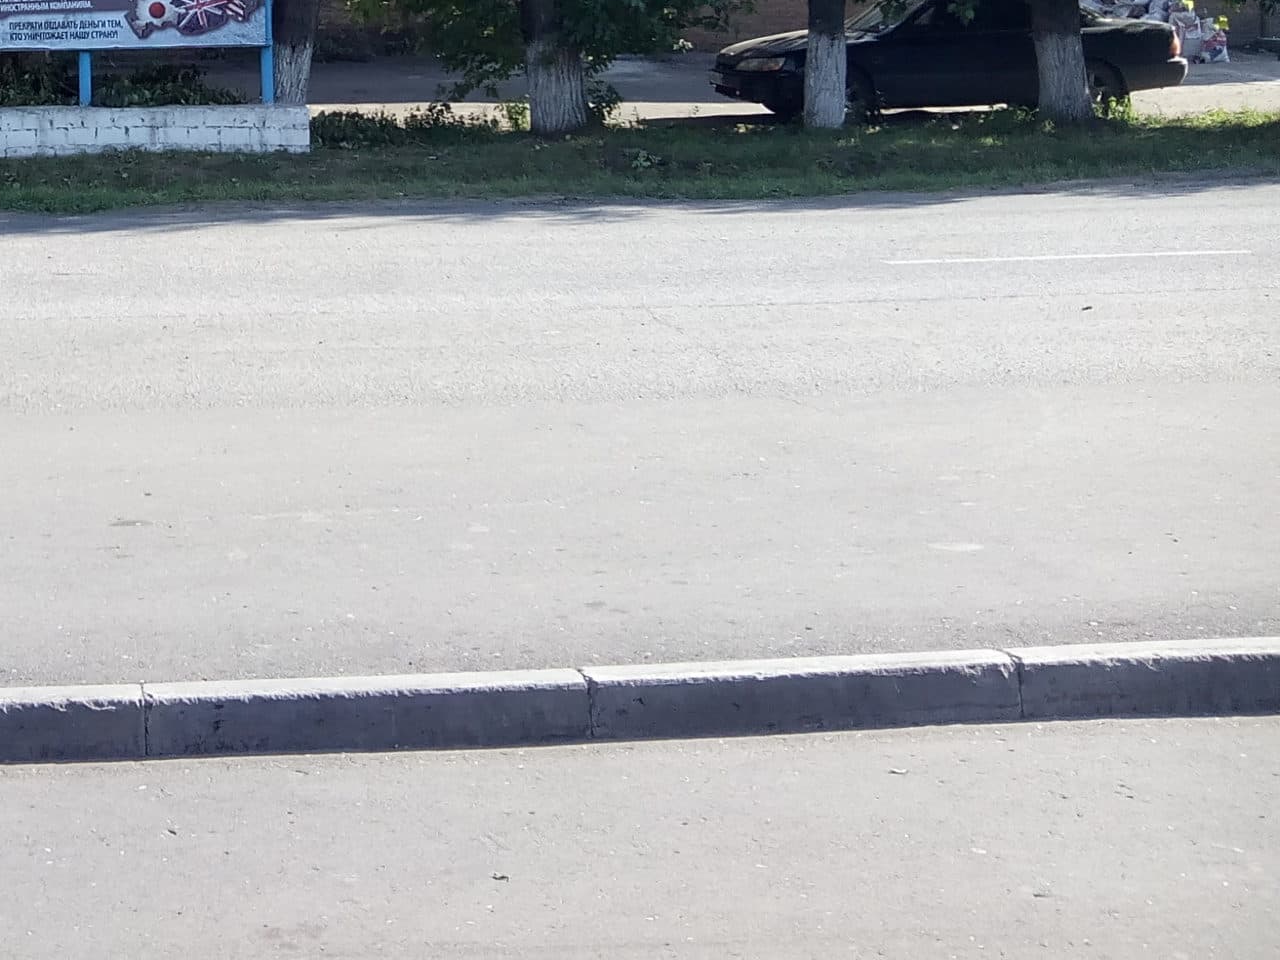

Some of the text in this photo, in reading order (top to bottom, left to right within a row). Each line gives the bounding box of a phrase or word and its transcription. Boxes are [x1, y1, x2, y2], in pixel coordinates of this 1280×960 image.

[0, 2, 49, 12] ИНОСТРАННЫМ
[9, 20, 124, 30] ПРЕКРАТИ ОТДАВАТЬ ДЕНЬГИ ТЕМ,
[9, 30, 118, 40] КТО УНИЧТОЖАЕТ НАШУ СТРАНУ!
